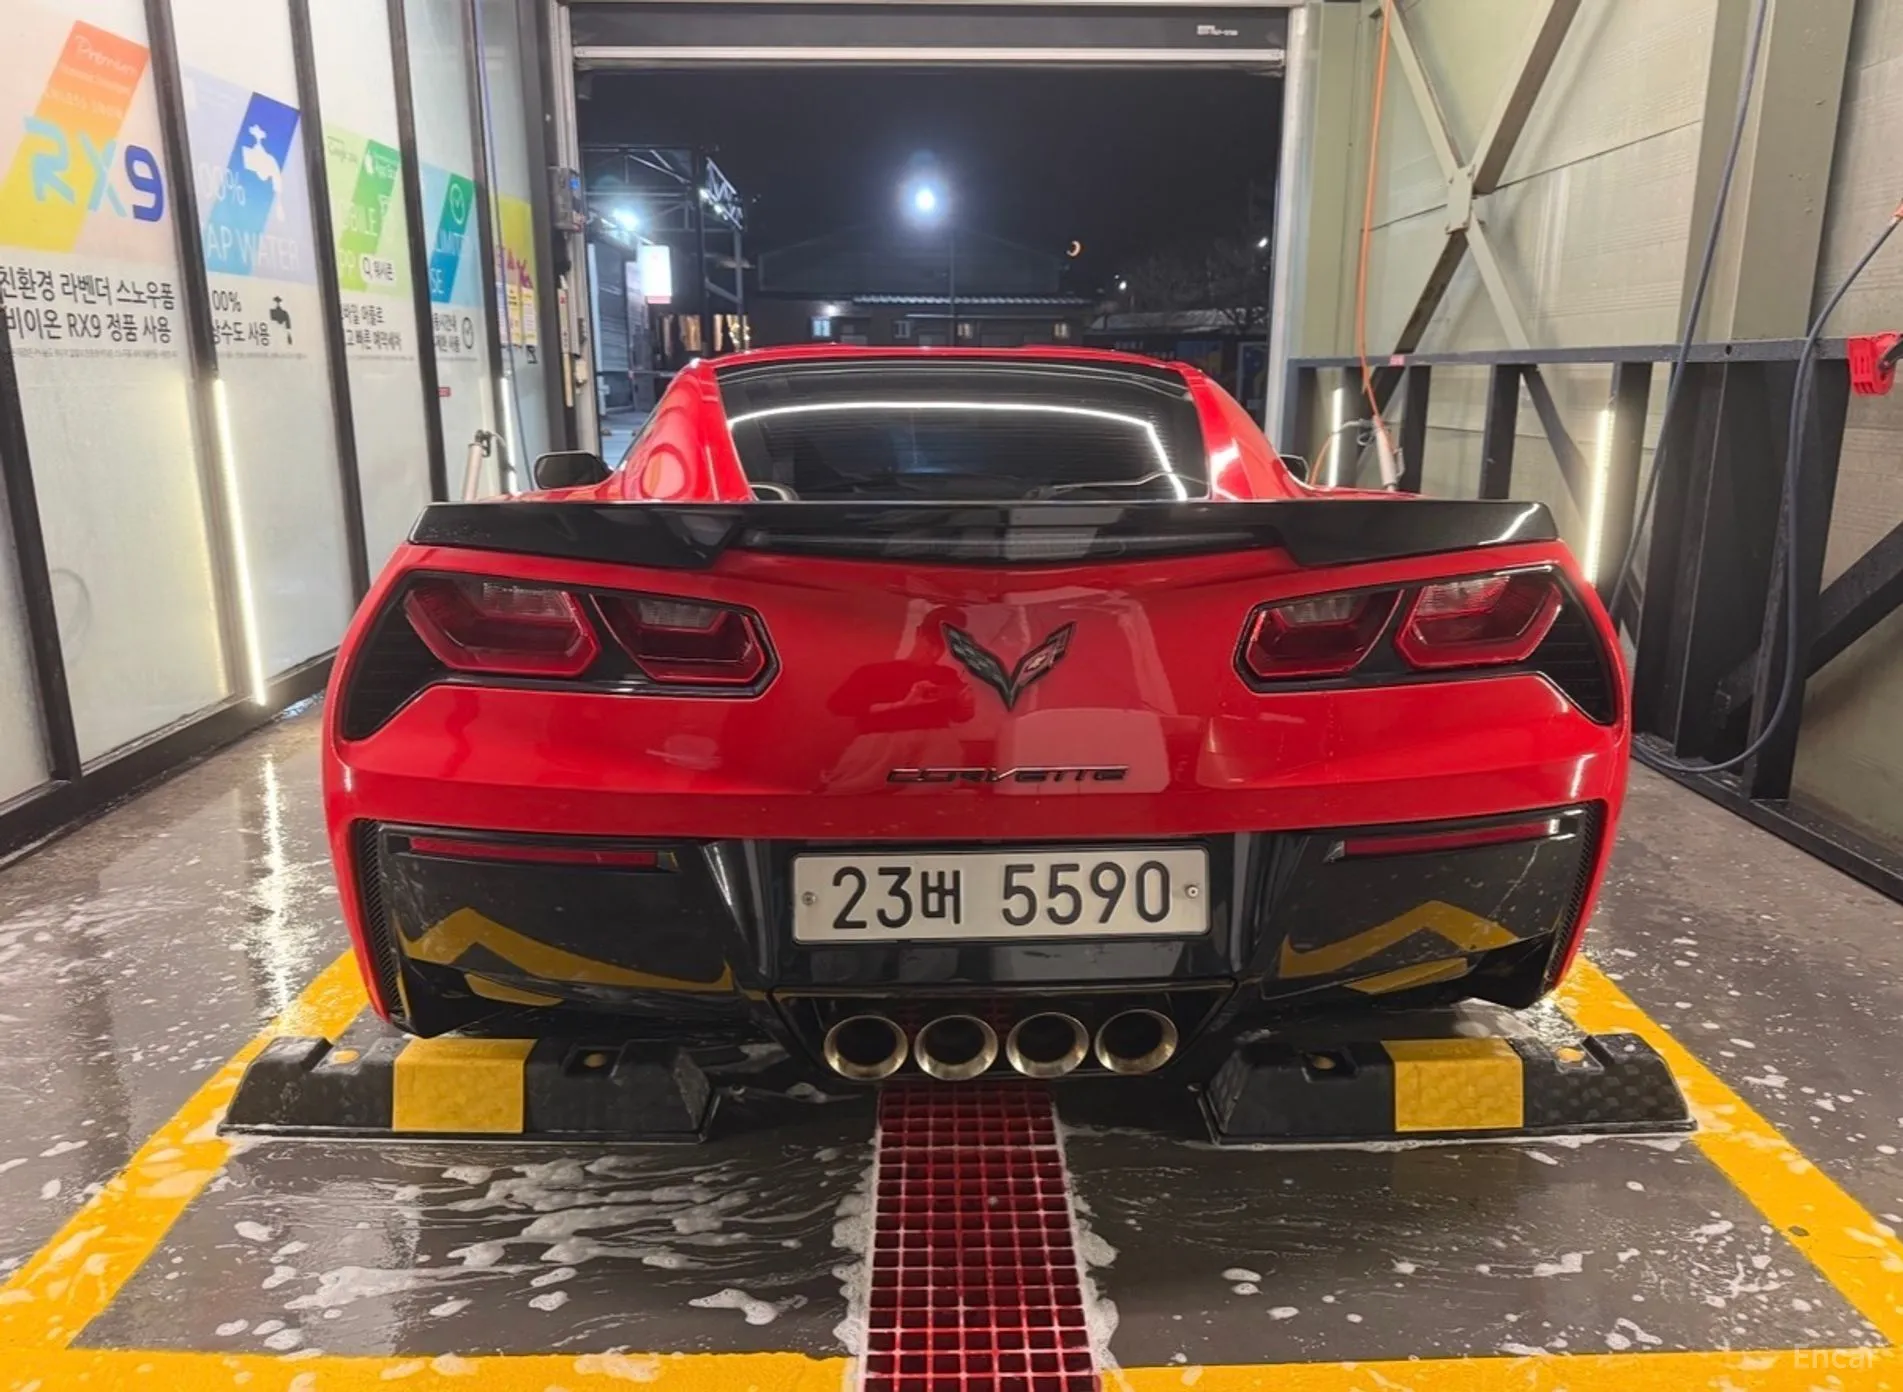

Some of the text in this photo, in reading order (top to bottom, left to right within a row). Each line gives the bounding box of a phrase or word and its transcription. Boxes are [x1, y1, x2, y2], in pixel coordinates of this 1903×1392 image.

[23, 116, 164, 222] RX9
[200, 222, 236, 262] AP
[0, 266, 175, 310] 친환경 라벤더 스노우폼
[67, 312, 102, 338] RX9
[106, 312, 138, 342] 정품
[143, 315, 172, 343] 사용
[248, 321, 270, 347] 사용
[887, 766, 1129, 783] CORVETTE
[832, 860, 1171, 930] 23버 5590
